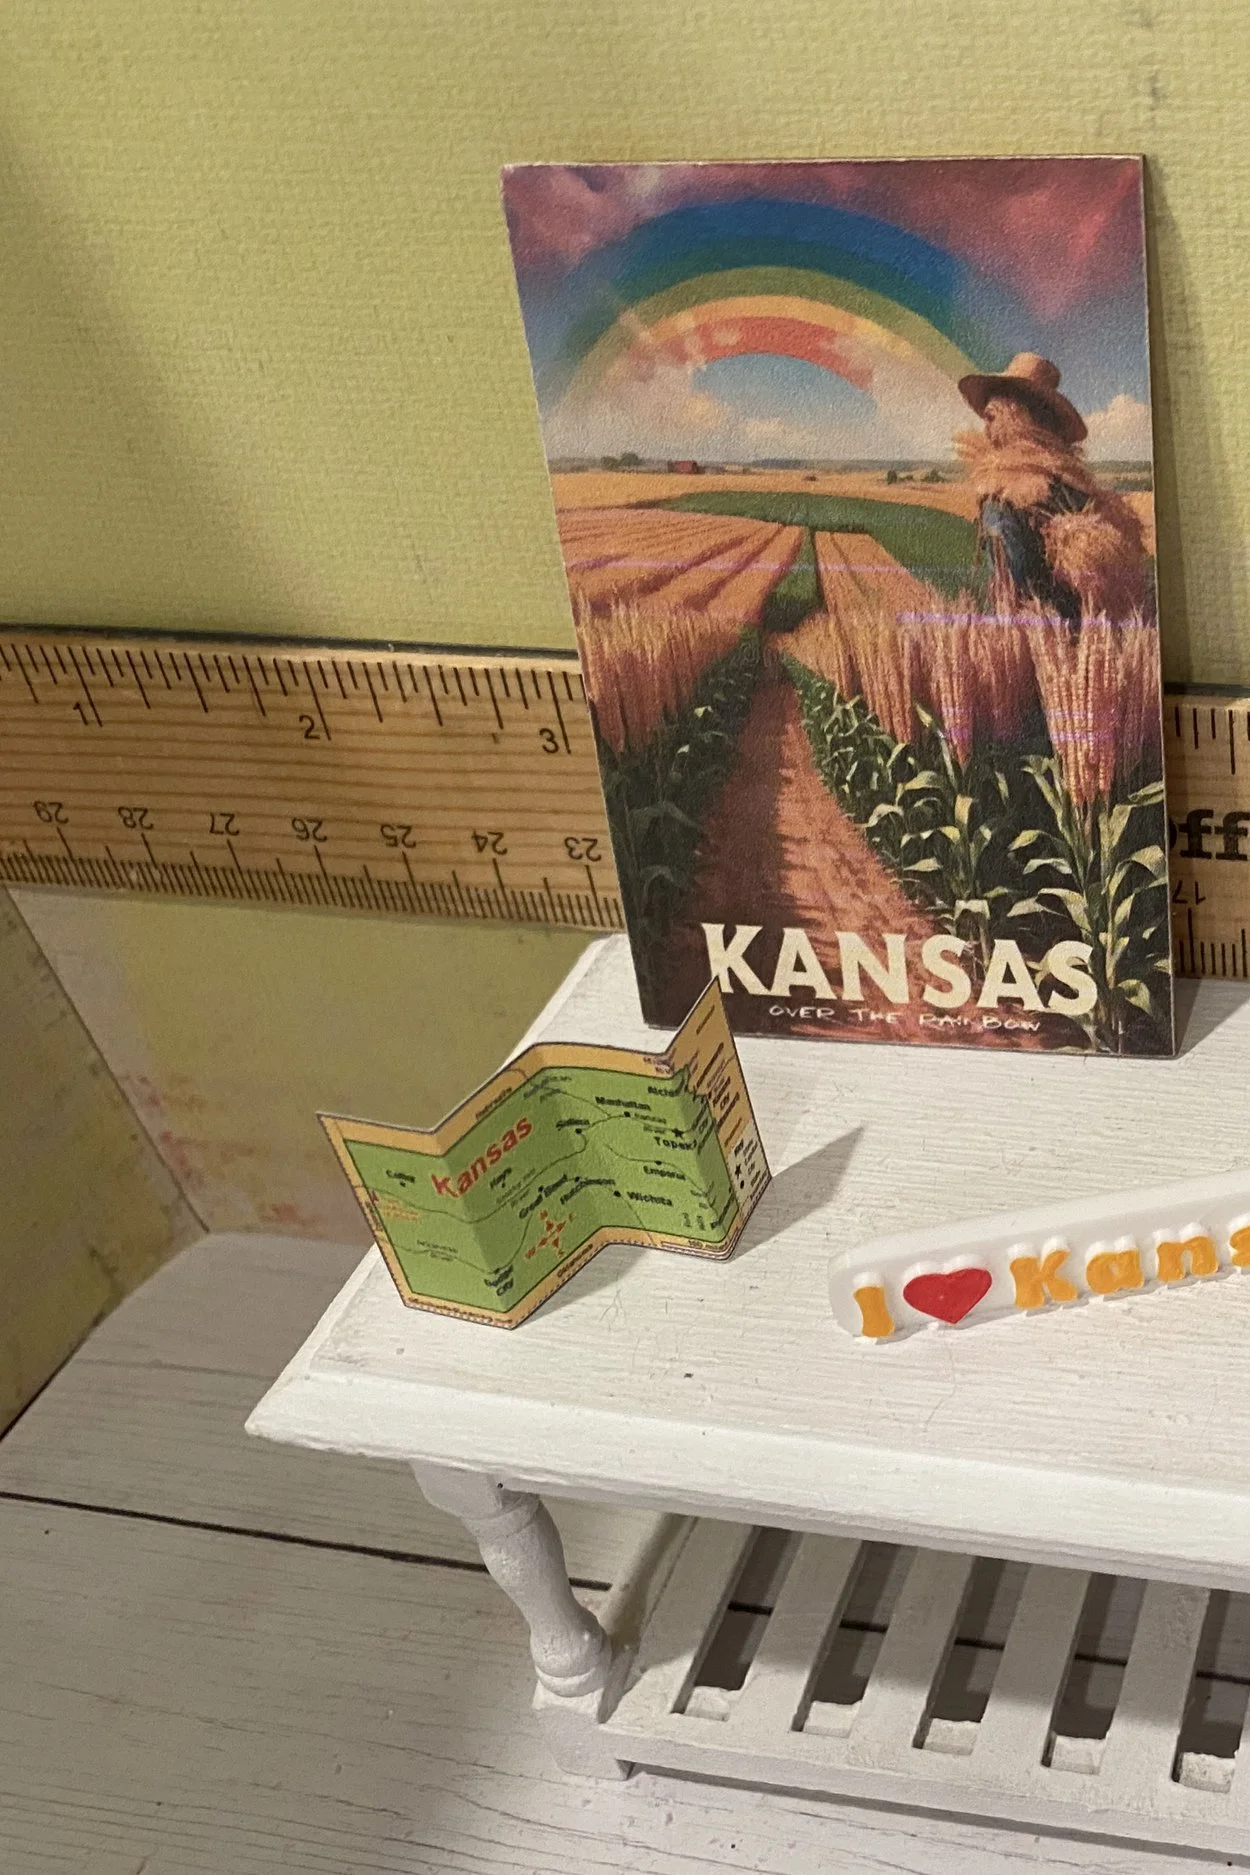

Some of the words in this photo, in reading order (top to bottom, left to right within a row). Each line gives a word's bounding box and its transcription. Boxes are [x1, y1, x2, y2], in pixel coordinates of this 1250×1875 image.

[73, 702, 89, 726] 1
[299, 715, 321, 740] 2
[541, 728, 559, 753] 3
[33, 801, 69, 825] 29
[118, 806, 154, 831] 28
[208, 811, 240, 837] 27
[291, 818, 328, 843] 26
[380, 824, 417, 849] 25
[472, 830, 508, 856] 24
[564, 836, 602, 862] 23
[1172, 879, 1206, 905] 17
[701, 922, 1098, 1016] KANSAS
[768, 1004, 836, 1020] OVER
[848, 1007, 903, 1025] THE
[430, 1117, 533, 1199] Kansas
[853, 1284, 895, 1338] I
